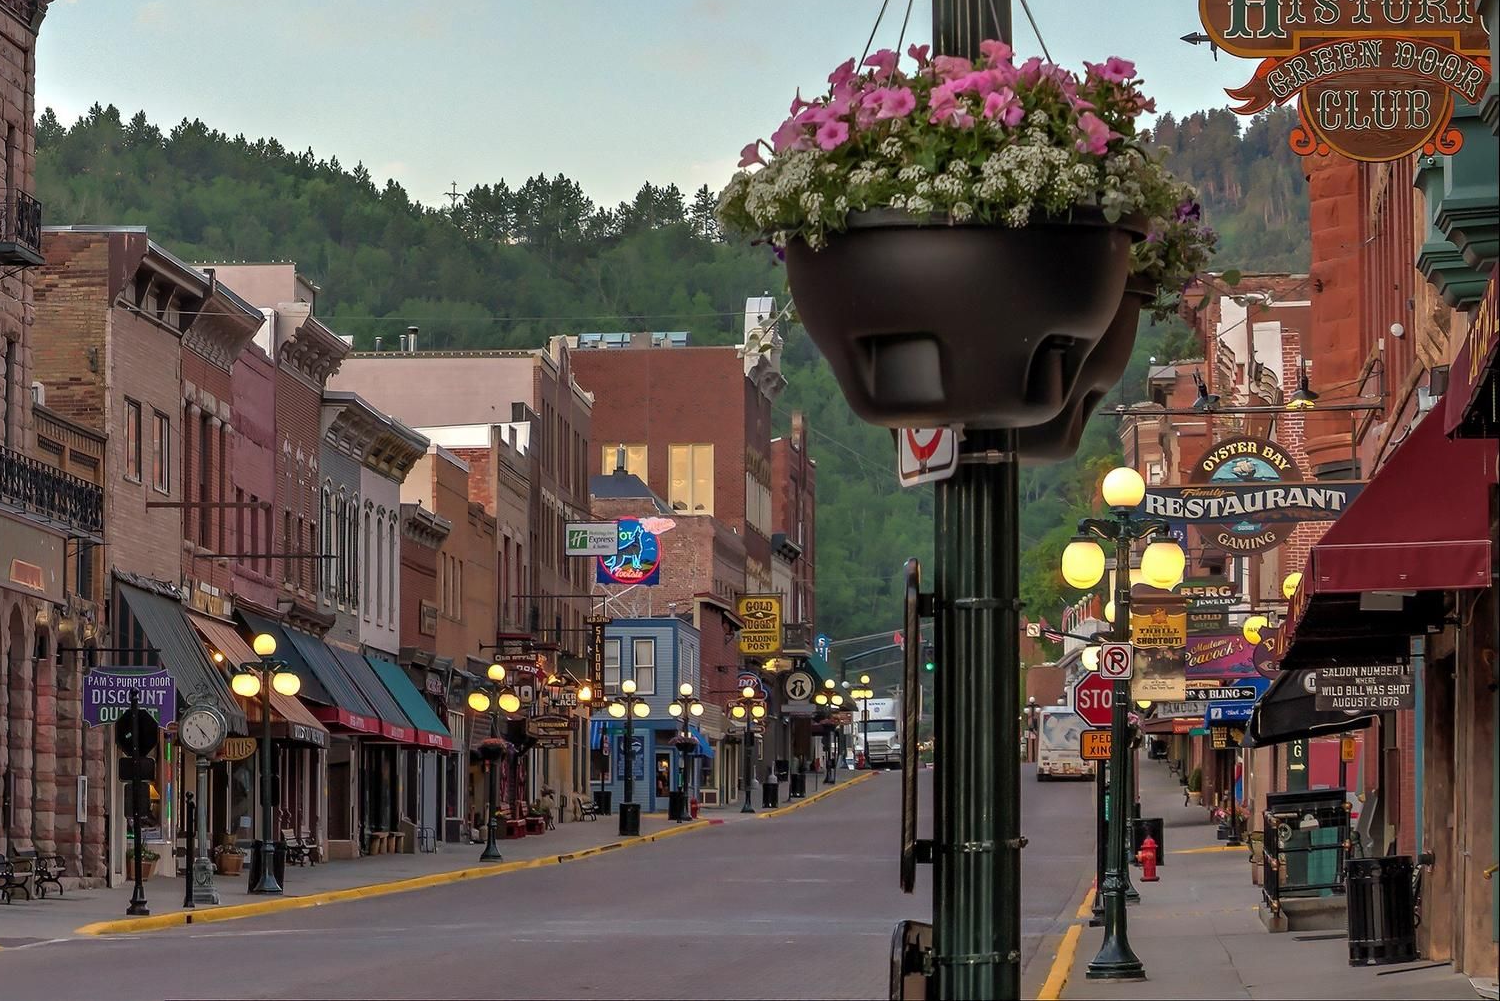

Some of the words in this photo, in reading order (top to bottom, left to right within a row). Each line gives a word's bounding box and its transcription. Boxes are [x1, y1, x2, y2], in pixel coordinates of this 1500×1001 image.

[1267, 40, 1382, 97] GREEN
[1392, 41, 1484, 98] DOOR
[1317, 90, 1431, 130] CLUB
[1202, 441, 1257, 471] OYSTER
[1262, 445, 1291, 470] BAY
[1180, 487, 1236, 499] Family
[1145, 487, 1347, 519] RESTAURANT
[588, 536, 615, 544] Express
[1218, 531, 1276, 550] GAMING
[746, 601, 773, 612] GOLD
[1196, 598, 1237, 607] JEWELRY
[743, 617, 777, 629] NUGGET
[1136, 637, 1182, 645] SHOOTOUT!
[1322, 667, 1358, 677] SALOON
[1360, 665, 1399, 676] NUMBER
[88, 676, 114, 687] PAM'S
[116, 678, 147, 687] PURPLE
[150, 677, 171, 687] DOOR
[1209, 688, 1240, 699] BLING
[1322, 686, 1343, 696] WILD
[1346, 685, 1365, 695] BILL
[1366, 685, 1385, 695] WAS
[1387, 684, 1411, 695] SHOT
[1080, 689, 1112, 709] STO
[1332, 697, 1368, 707] AUGUST
[1370, 697, 1377, 707] 2
[1379, 697, 1400, 707] 1876
[100, 707, 158, 721] OUTT
[1091, 734, 1112, 743] PED
